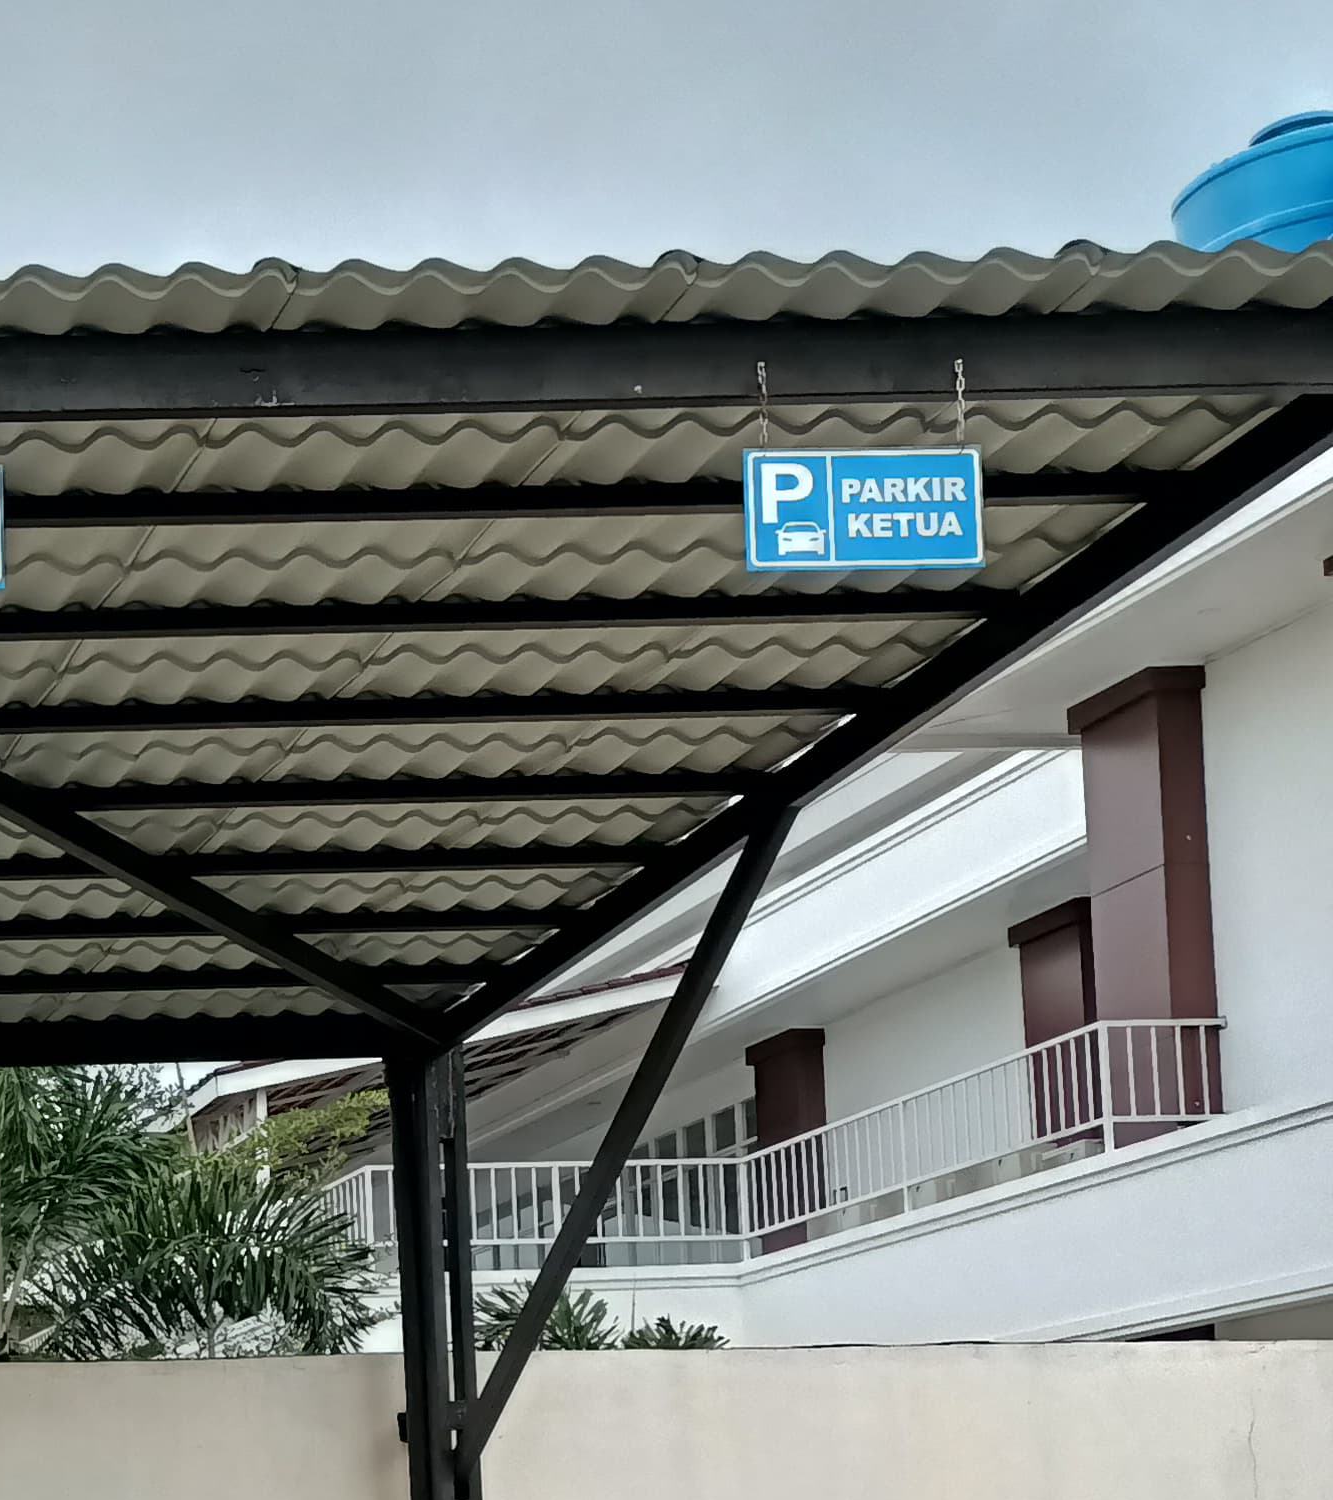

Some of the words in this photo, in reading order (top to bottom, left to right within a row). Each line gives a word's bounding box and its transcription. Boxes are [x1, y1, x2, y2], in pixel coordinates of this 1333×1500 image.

[760, 463, 813, 524] P
[841, 477, 967, 504] PARKIR
[847, 512, 963, 538] KETUA
